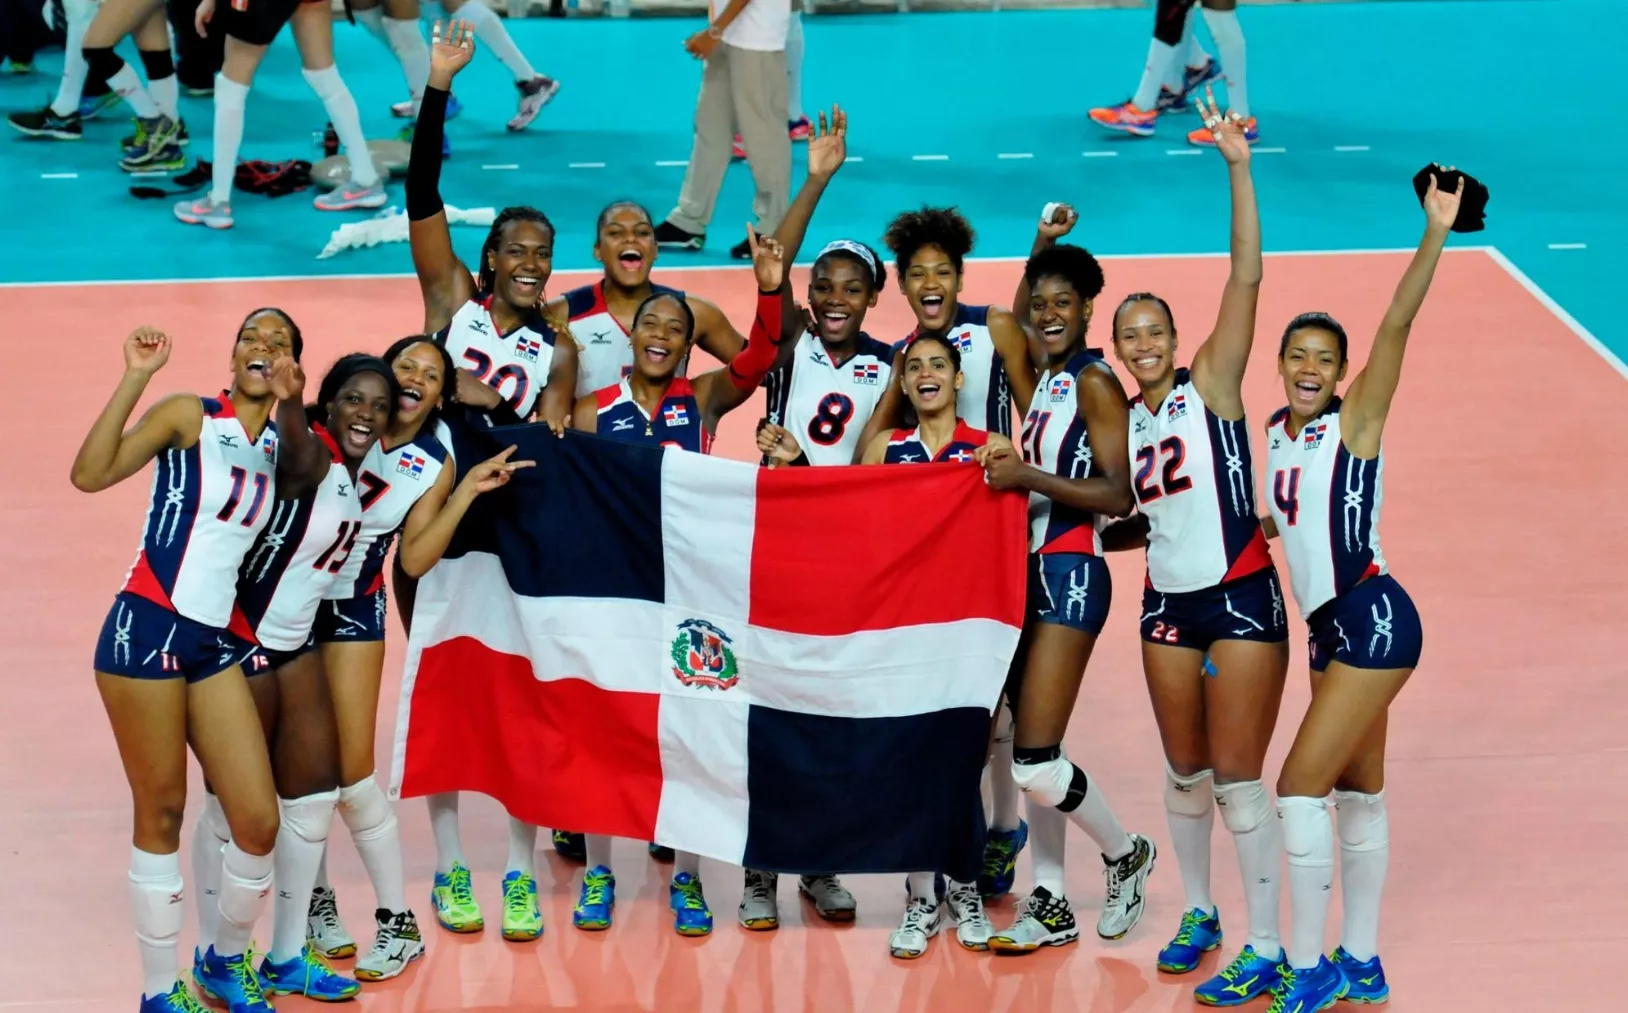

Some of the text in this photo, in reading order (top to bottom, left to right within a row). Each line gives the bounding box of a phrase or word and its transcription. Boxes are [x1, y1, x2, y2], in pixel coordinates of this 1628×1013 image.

[518, 351, 534, 360] DOM
[807, 392, 855, 446] 8
[1171, 408, 1186, 420] DOM
[1021, 409, 1051, 467] 21
[359, 470, 391, 513] 7
[400, 467, 417, 477] DOM
[1134, 434, 1193, 505] 22
[216, 464, 269, 527] 11
[1274, 467, 1301, 526] 4
[312, 521, 362, 573] 15
[1151, 620, 1180, 644] 22
[160, 652, 180, 671] 11
